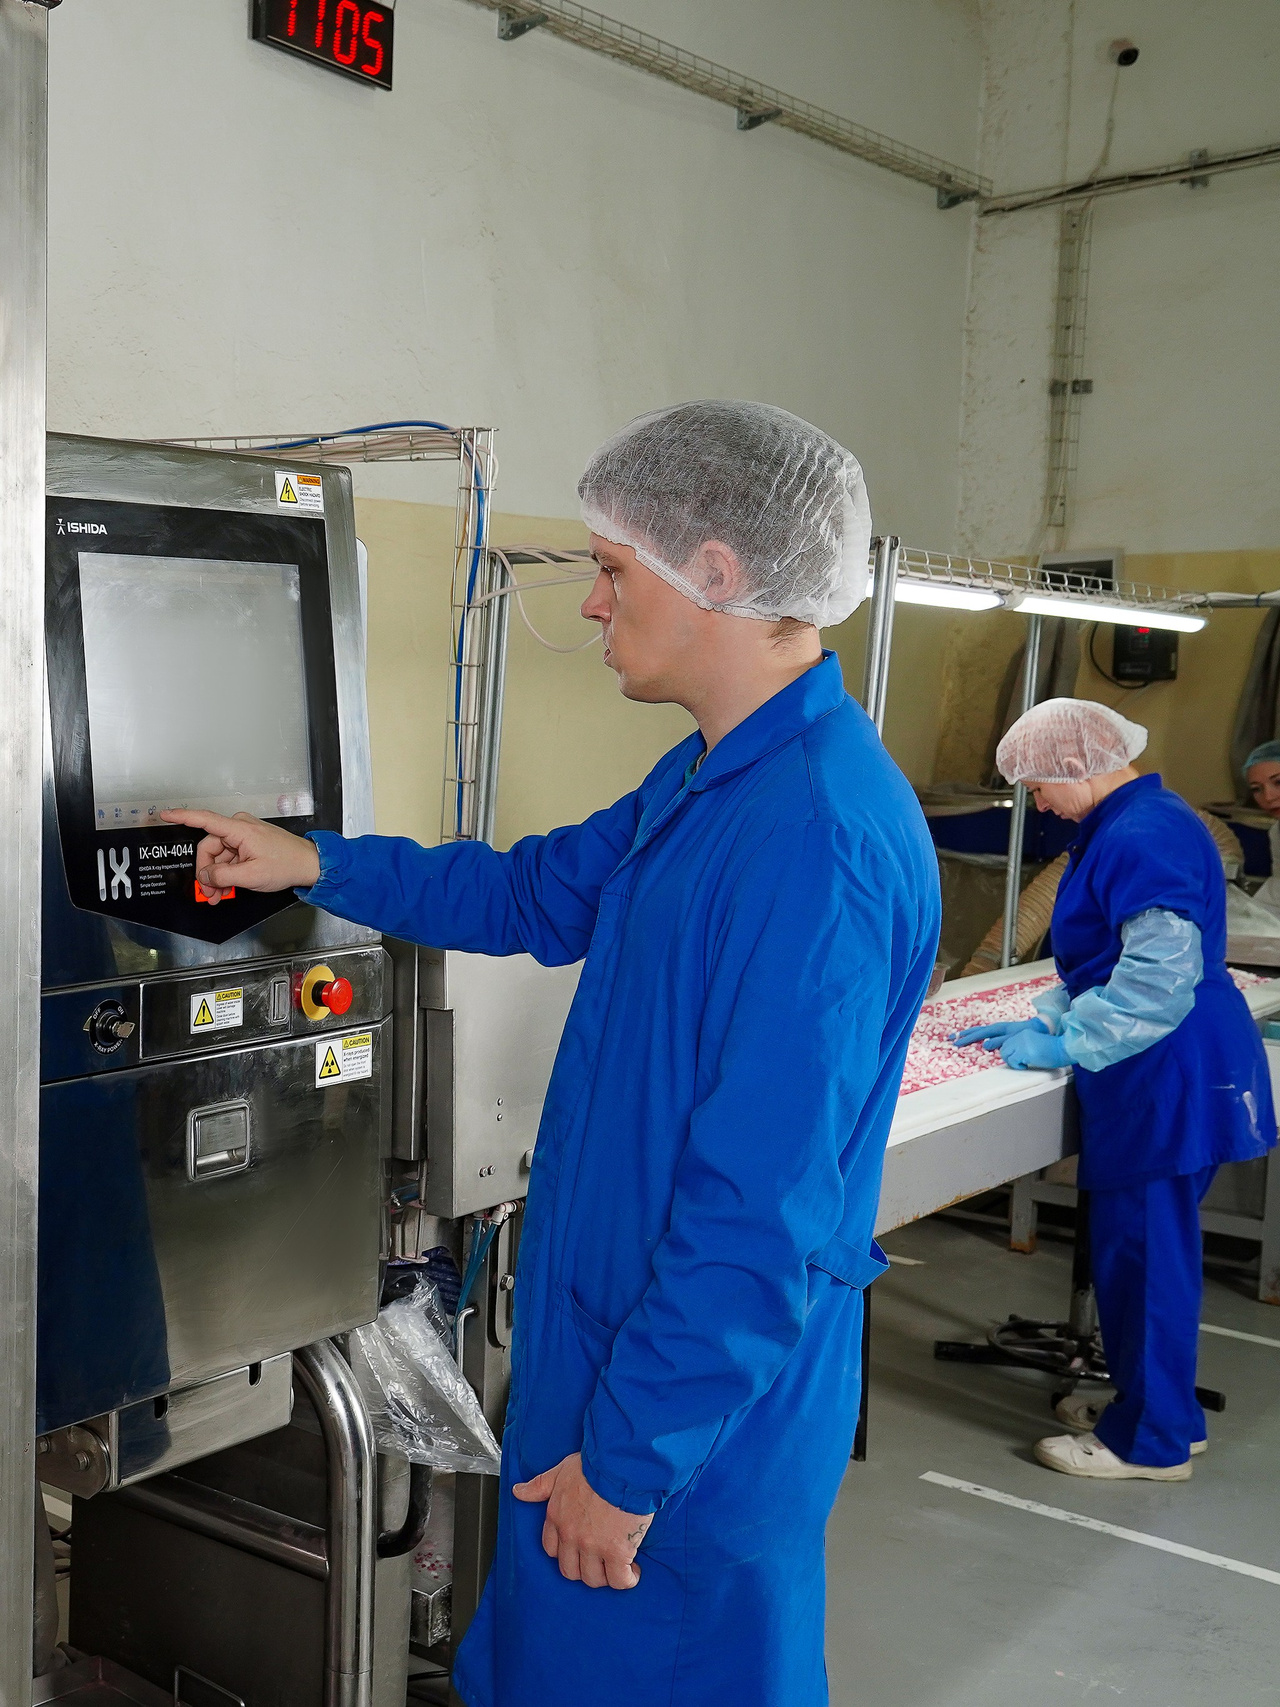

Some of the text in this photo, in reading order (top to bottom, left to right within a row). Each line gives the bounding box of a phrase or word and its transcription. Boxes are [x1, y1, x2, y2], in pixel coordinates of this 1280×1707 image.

[67, 522, 108, 535] ISHIDA
[139, 843, 193, 860] IX-GN-4044
[97, 847, 133, 902] IX
[222, 991, 240, 999] CAUTION
[92, 1007, 101, 1020] OFF
[117, 1005, 125, 1015] ON
[349, 1037, 370, 1046] CAUTION
